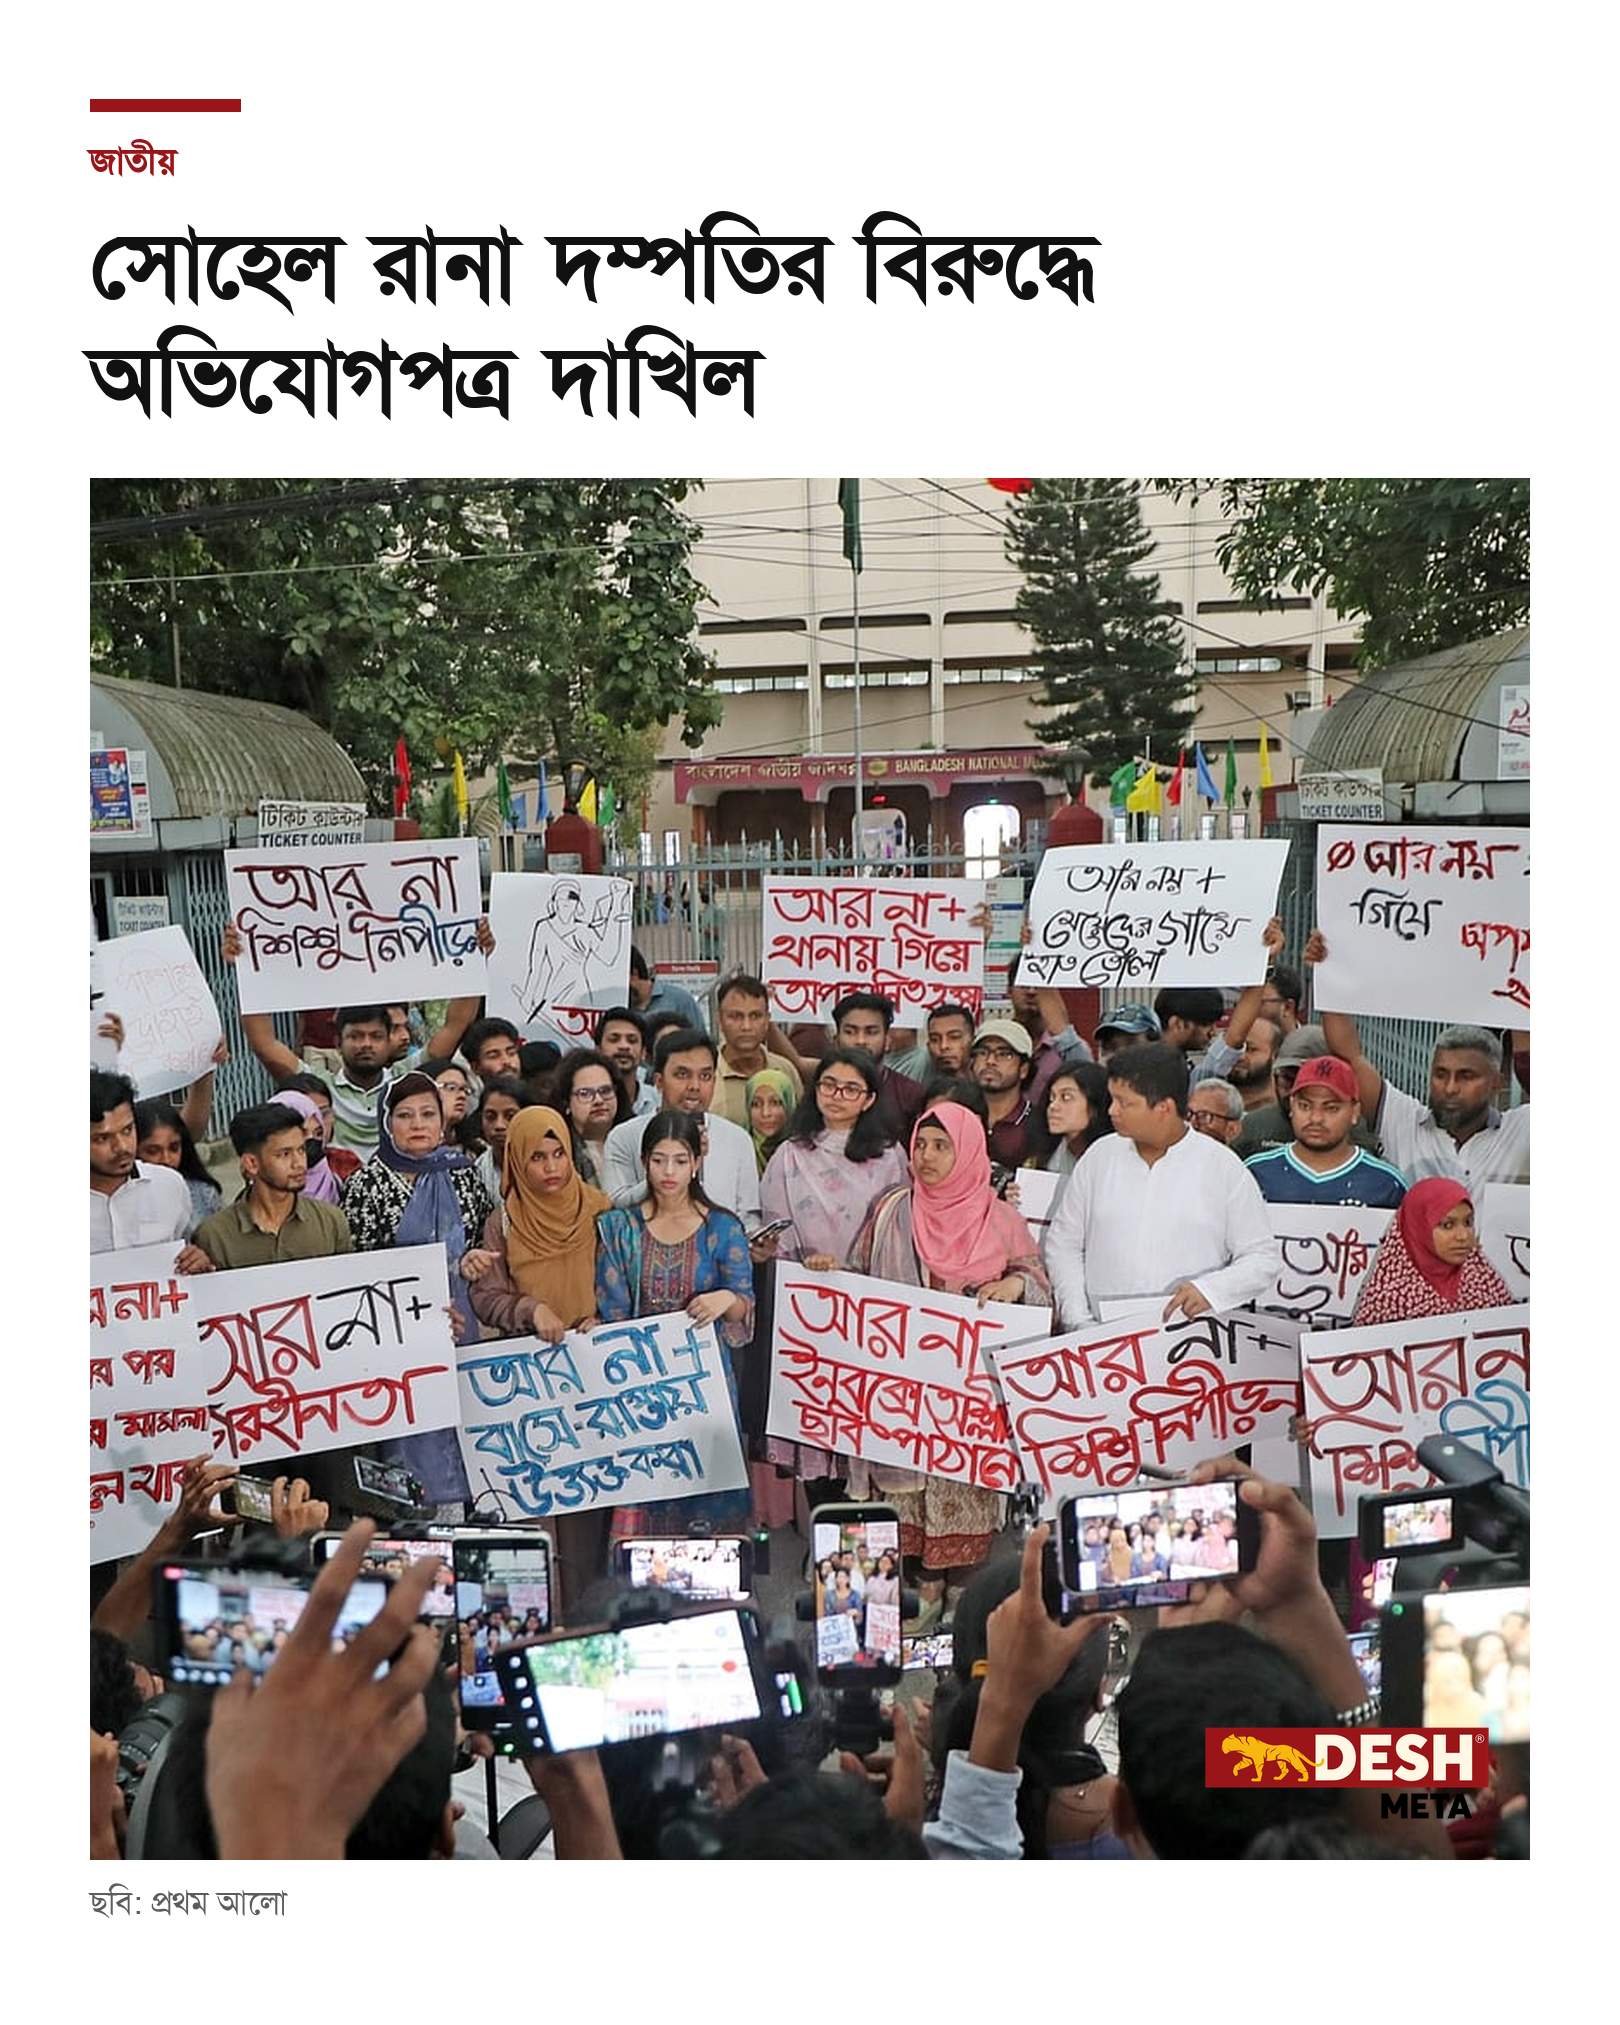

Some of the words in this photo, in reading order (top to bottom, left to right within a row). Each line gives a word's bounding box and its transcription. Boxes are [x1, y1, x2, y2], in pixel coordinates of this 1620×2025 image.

[896, 758, 965, 774] BANGLADESH
[969, 756, 1020, 771] NATIONAL
[260, 832, 308, 848] TICKET
[311, 831, 362, 847] COUNTER
[1302, 804, 1333, 818] TICKET
[1335, 804, 1382, 819] COUNTER
[1363, 836, 1438, 880] আর
[233, 862, 373, 919] আর
[391, 855, 459, 914] না
[768, 887, 877, 929] আর
[879, 889, 947, 929] না
[768, 934, 885, 973] থানায়
[891, 922, 982, 973] গিয়ে
[316, 1276, 419, 1351] না
[784, 1282, 911, 1360] আর
[918, 1307, 1004, 1386] না
[457, 1343, 585, 1408] আর
[592, 1322, 668, 1386] না
[1001, 1328, 1160, 1401] আর
[1164, 1315, 1256, 1365] না
[1304, 1336, 1469, 1416] আর
